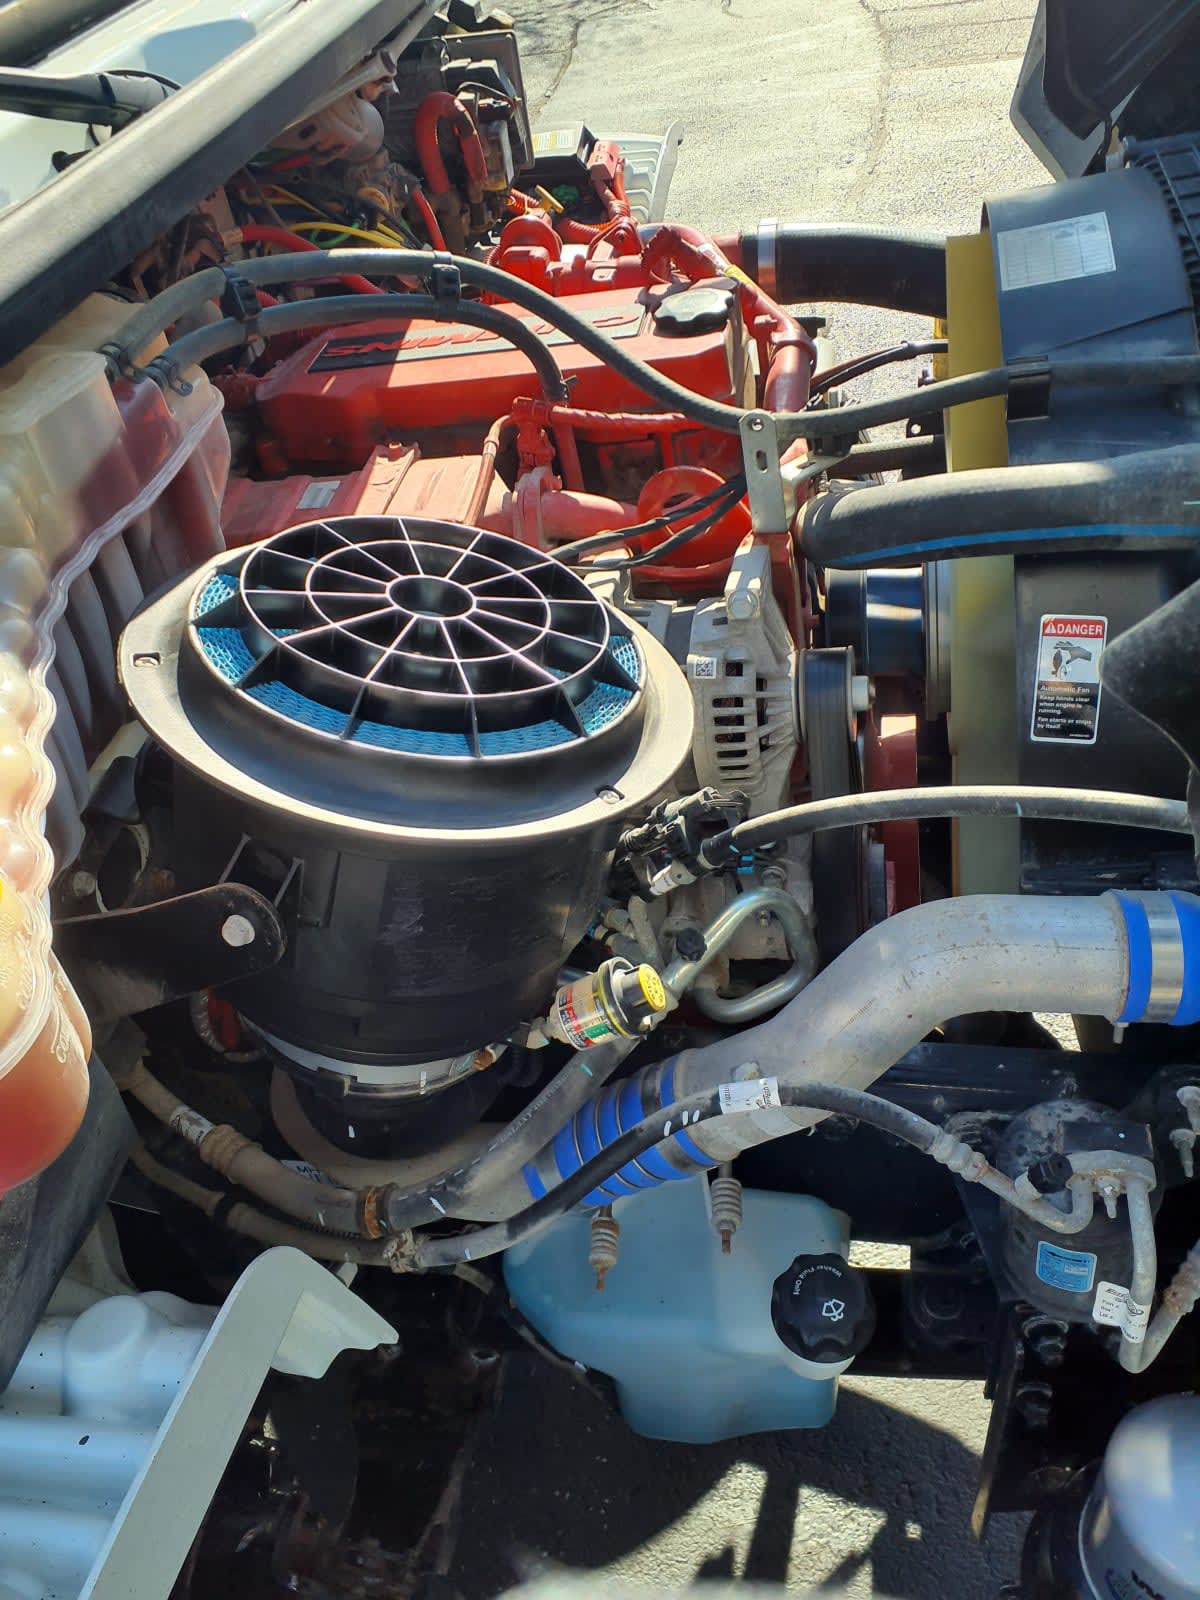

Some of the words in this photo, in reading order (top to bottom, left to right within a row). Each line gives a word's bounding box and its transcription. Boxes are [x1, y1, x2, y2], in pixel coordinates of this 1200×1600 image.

[320, 315, 640, 358] CMINS
[1056, 624, 1103, 636] DANGER
[799, 1267, 815, 1280] Fluid
[816, 1265, 842, 1278] Washer
